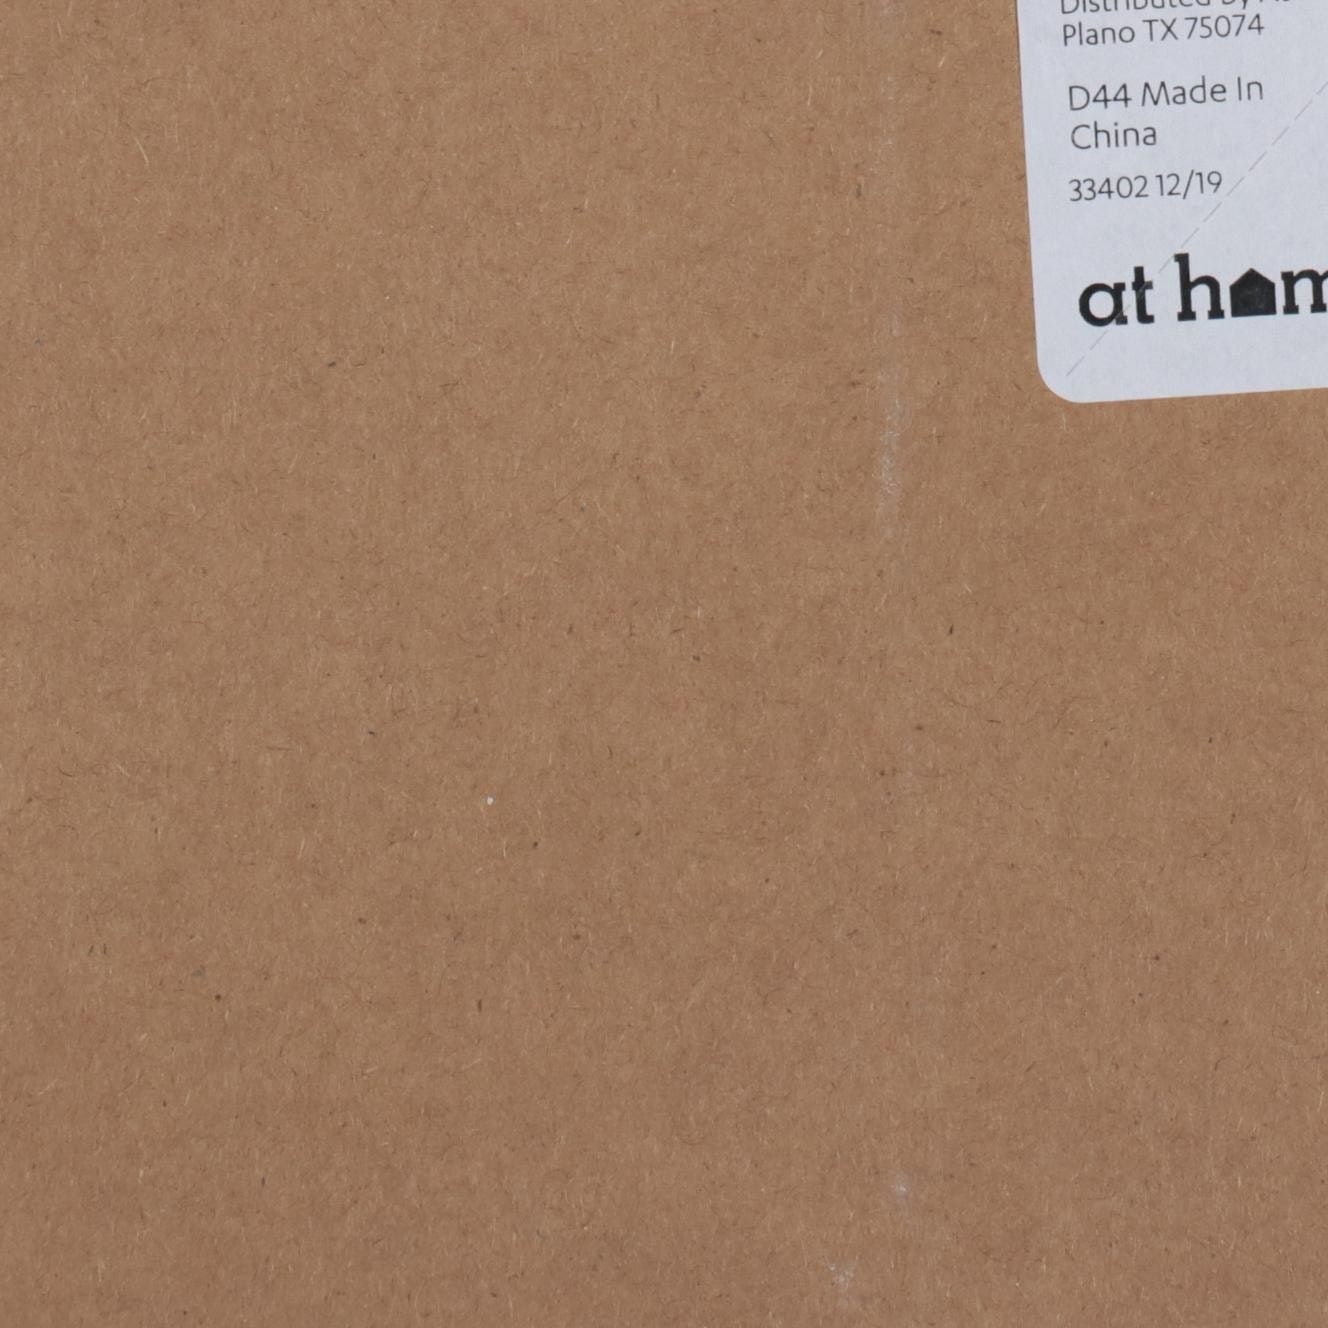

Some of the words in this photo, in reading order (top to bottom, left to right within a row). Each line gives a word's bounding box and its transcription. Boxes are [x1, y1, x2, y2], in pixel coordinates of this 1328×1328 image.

[1062, 21, 1137, 47] Plano
[1142, 19, 1179, 42] TX
[1184, 13, 1265, 40] 75074
[1068, 83, 1132, 111] D44
[1140, 75, 1228, 107] Made
[1236, 76, 1264, 102] In
[1070, 120, 1158, 150] China
[1078, 265, 1155, 327] at
